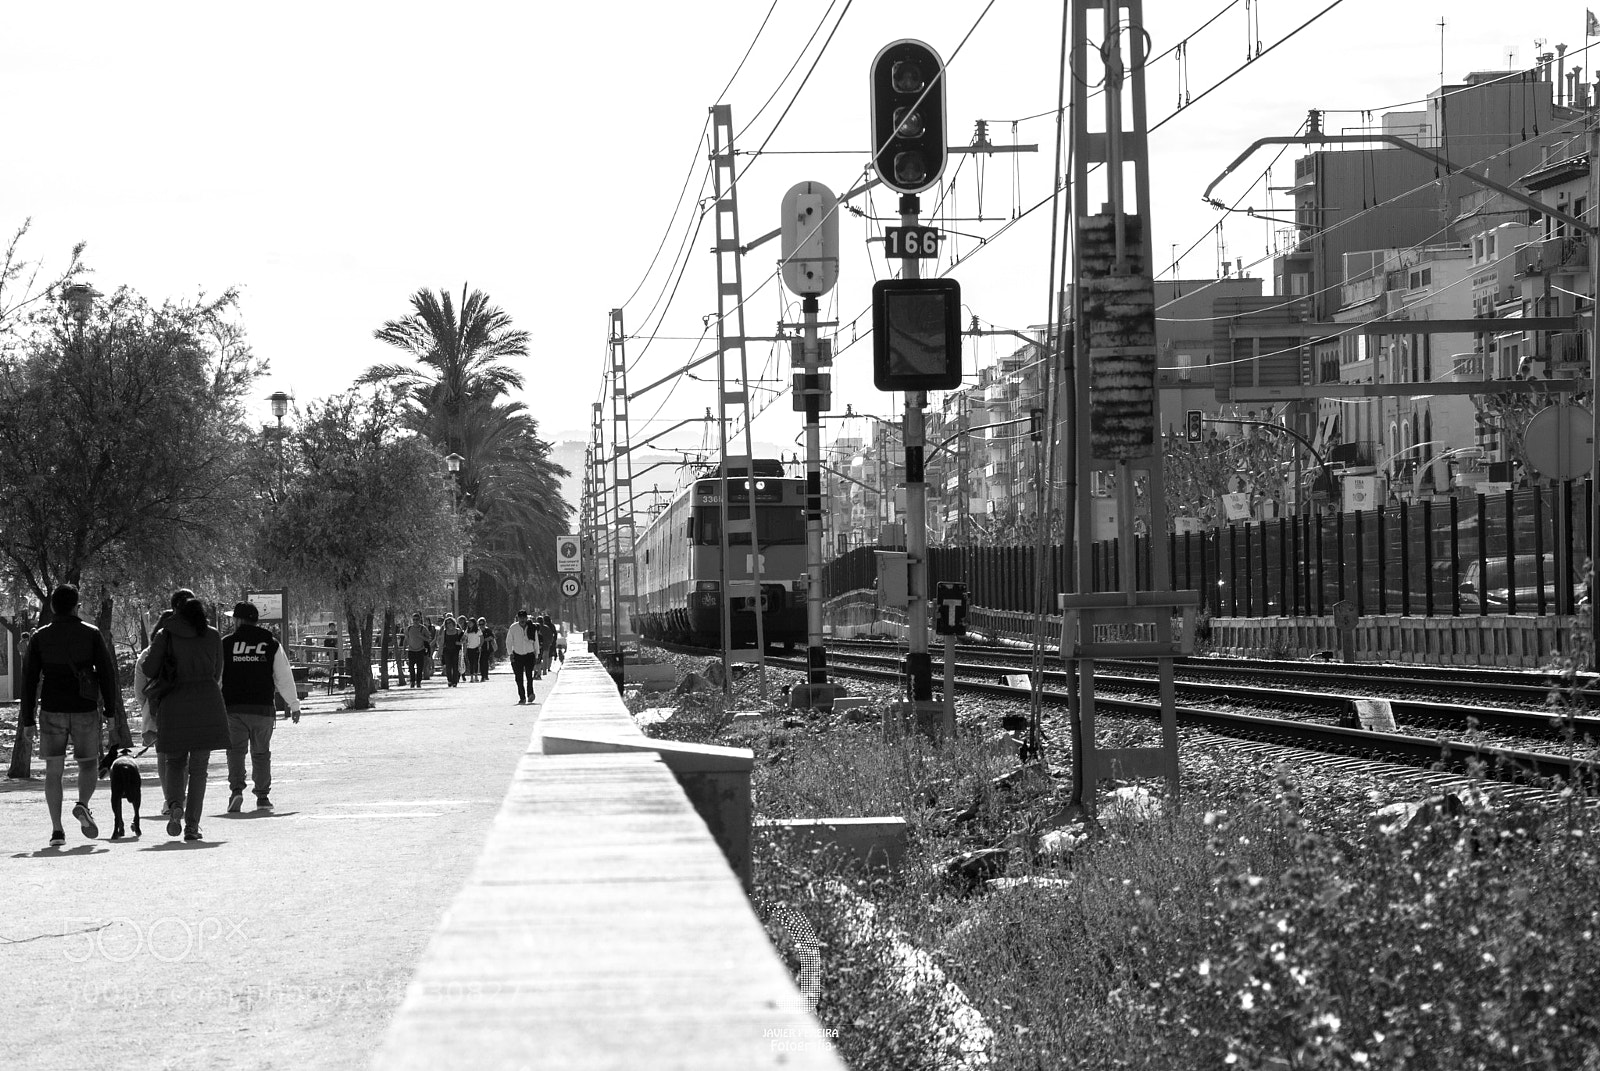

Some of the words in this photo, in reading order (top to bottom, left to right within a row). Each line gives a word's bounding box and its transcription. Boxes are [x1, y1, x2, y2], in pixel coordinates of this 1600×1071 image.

[889, 231, 936, 254] 166
[565, 584, 576, 592] 10
[942, 599, 962, 626] T
[232, 655, 259, 663] Reebok
